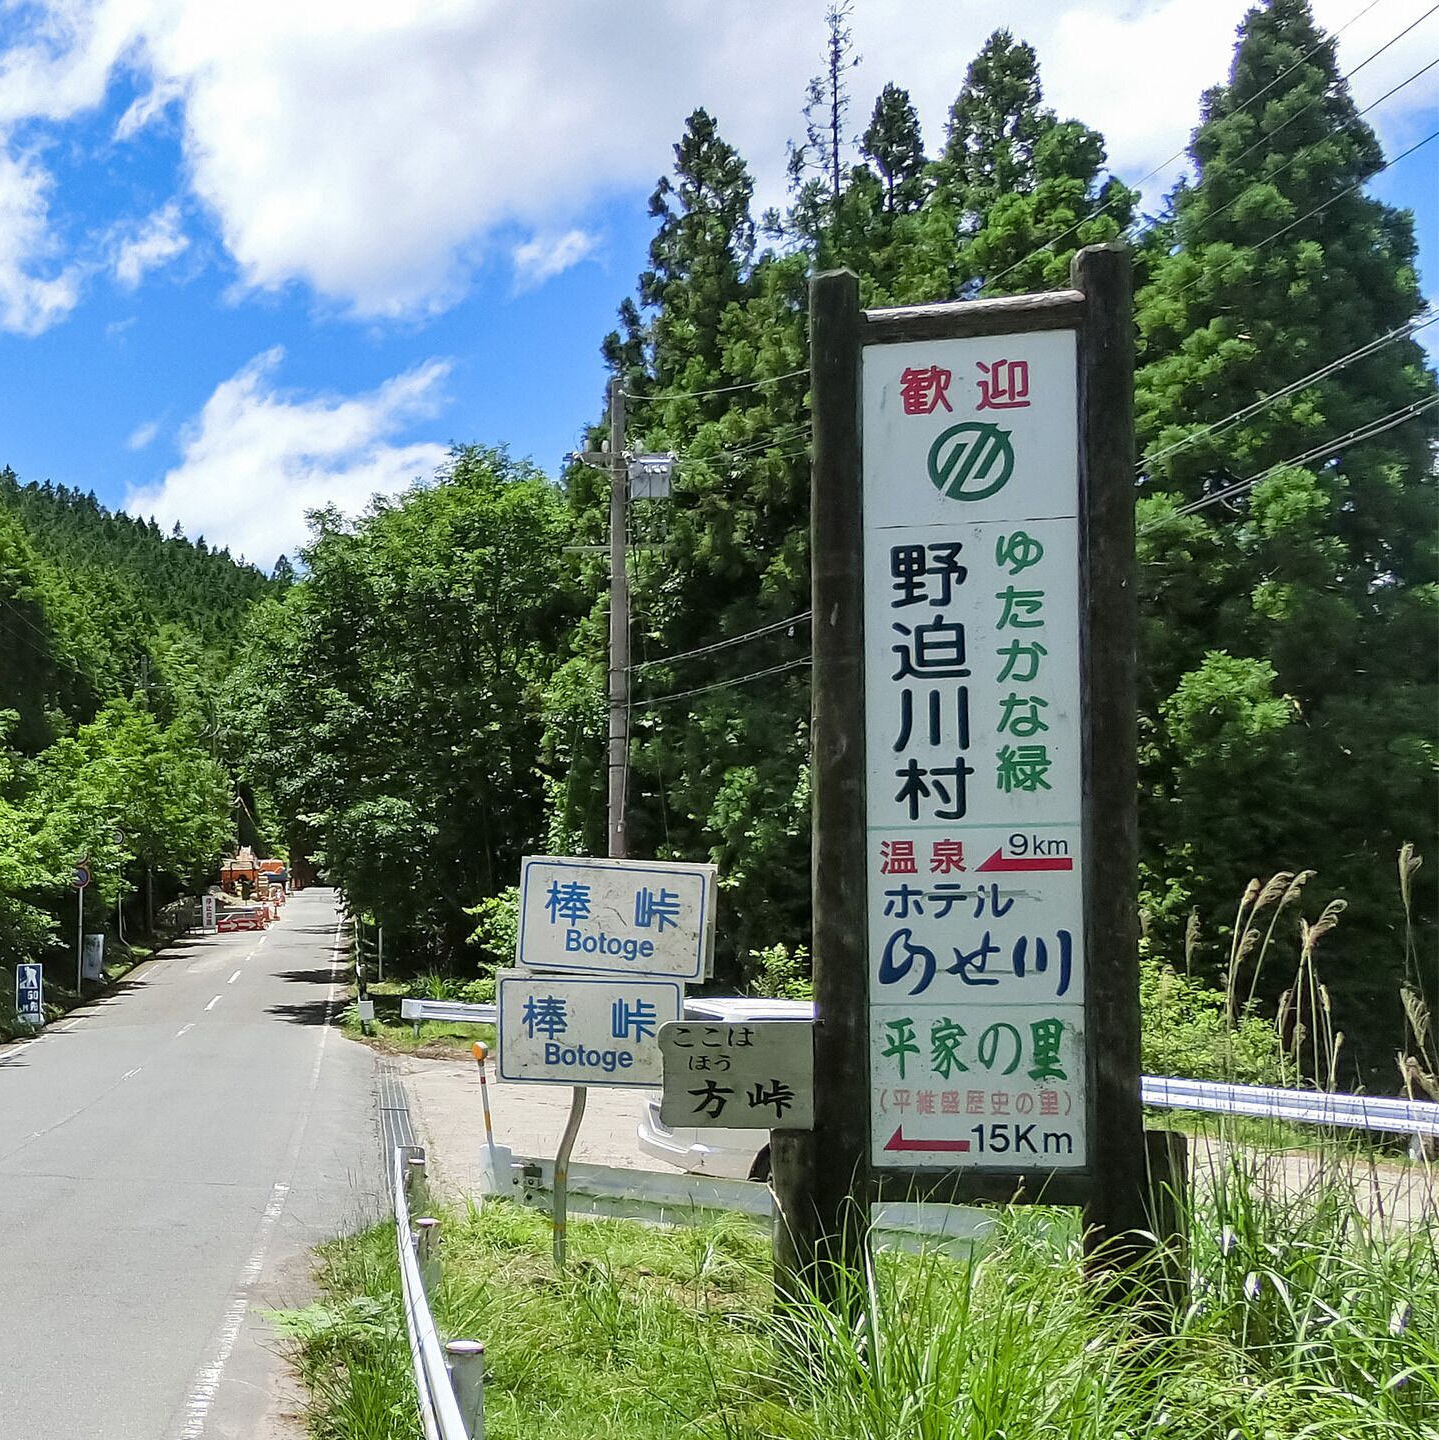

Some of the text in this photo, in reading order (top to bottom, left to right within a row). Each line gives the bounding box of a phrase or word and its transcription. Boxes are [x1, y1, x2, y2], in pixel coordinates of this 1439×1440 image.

[898, 358, 1032, 416] 歓迎
[890, 541, 975, 821] 野迫川村
[994, 530, 1053, 794] ゆたかな緑
[879, 838, 968, 875] 温泉
[1008, 832, 1069, 857] 9km
[544, 880, 681, 932] 棒峠
[883, 882, 1015, 919] ホテル
[565, 929, 654, 961] Botoge
[877, 927, 1073, 996] のせ川
[521, 995, 658, 1043] 棒峠
[672, 1027, 754, 1048] ここは
[544, 1043, 633, 1072] Botoge
[688, 1054, 732, 1072] ほう
[880, 1016, 1068, 1082] 平家の里
[687, 1079, 796, 1119] 方峠
[971, 1123, 1074, 1154] 15Km
